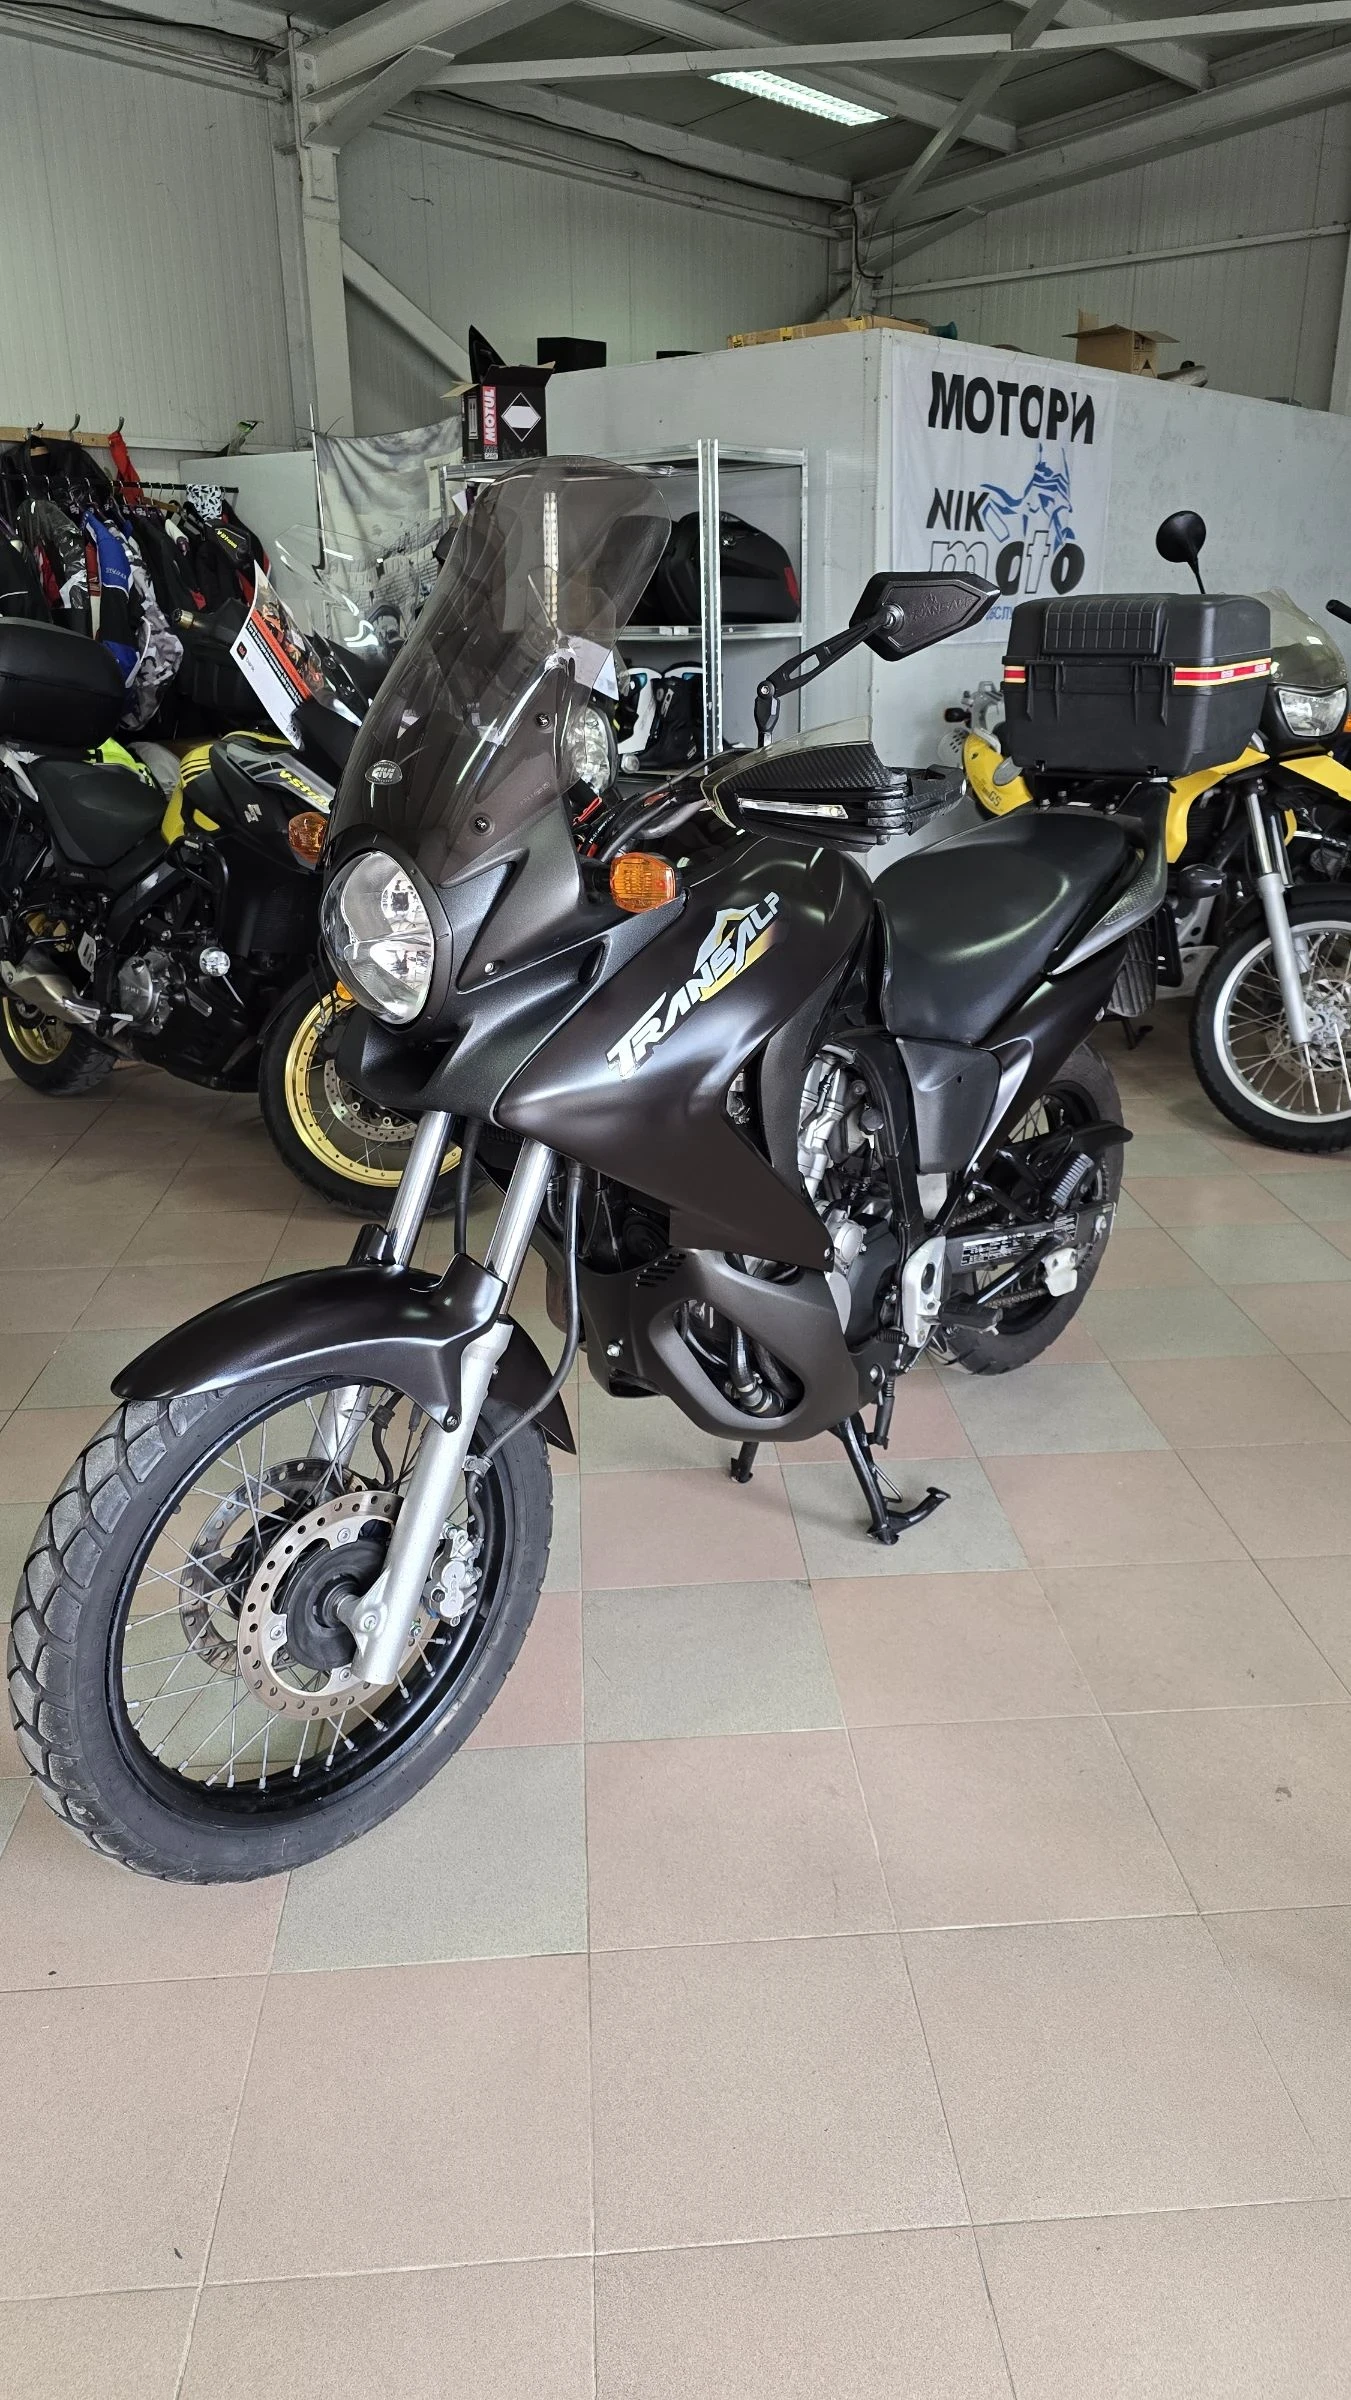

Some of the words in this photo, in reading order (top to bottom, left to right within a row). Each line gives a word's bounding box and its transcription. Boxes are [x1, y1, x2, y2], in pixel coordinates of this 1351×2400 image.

[484, 388, 497, 443] MOTUL
[928, 371, 1095, 444] МОТОРИ
[926, 487, 989, 532] NIK
[929, 529, 1085, 596] moto
[371, 766, 396, 780] GIVI
[606, 891, 780, 1080] TRANSALP
